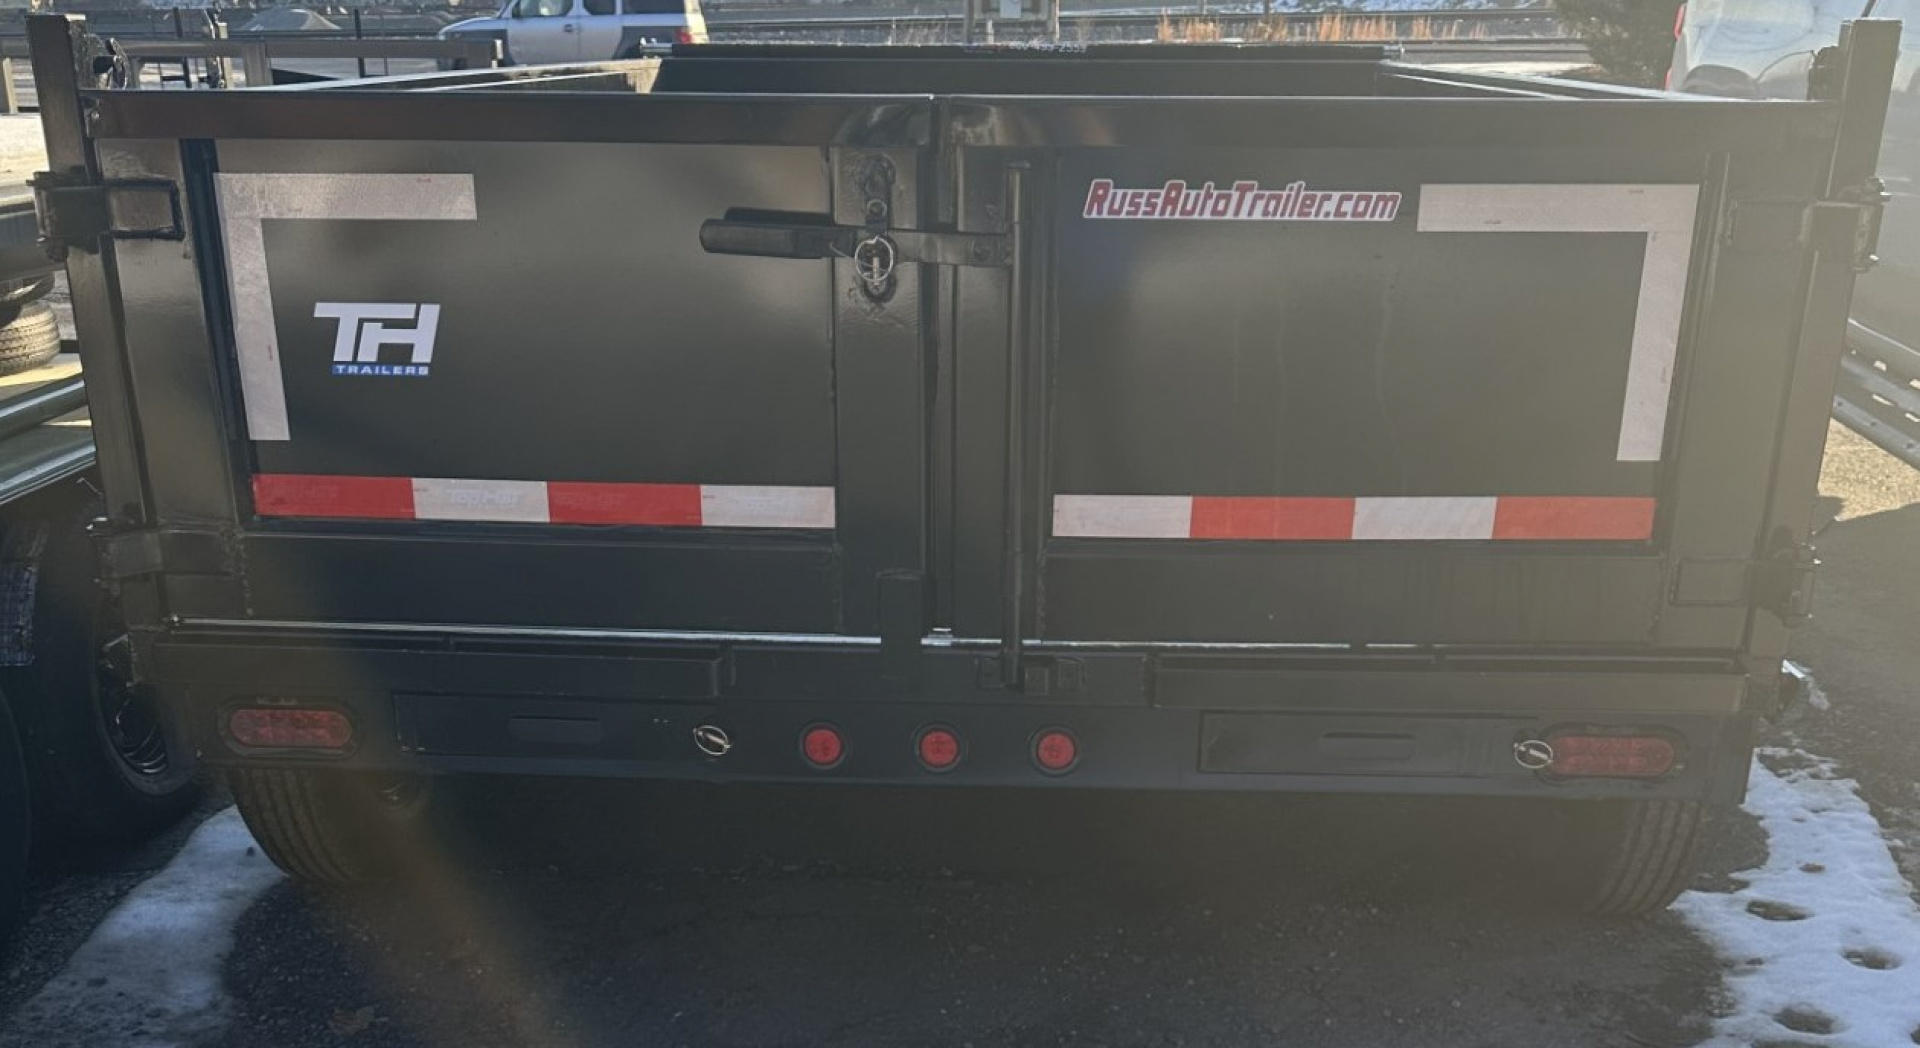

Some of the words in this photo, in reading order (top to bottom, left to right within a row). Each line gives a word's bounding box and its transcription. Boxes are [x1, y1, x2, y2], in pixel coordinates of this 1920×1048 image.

[1085, 180, 1401, 220] RussAutoTrailer.com
[314, 302, 440, 363] TH
[335, 364, 429, 376] TRAILERS
